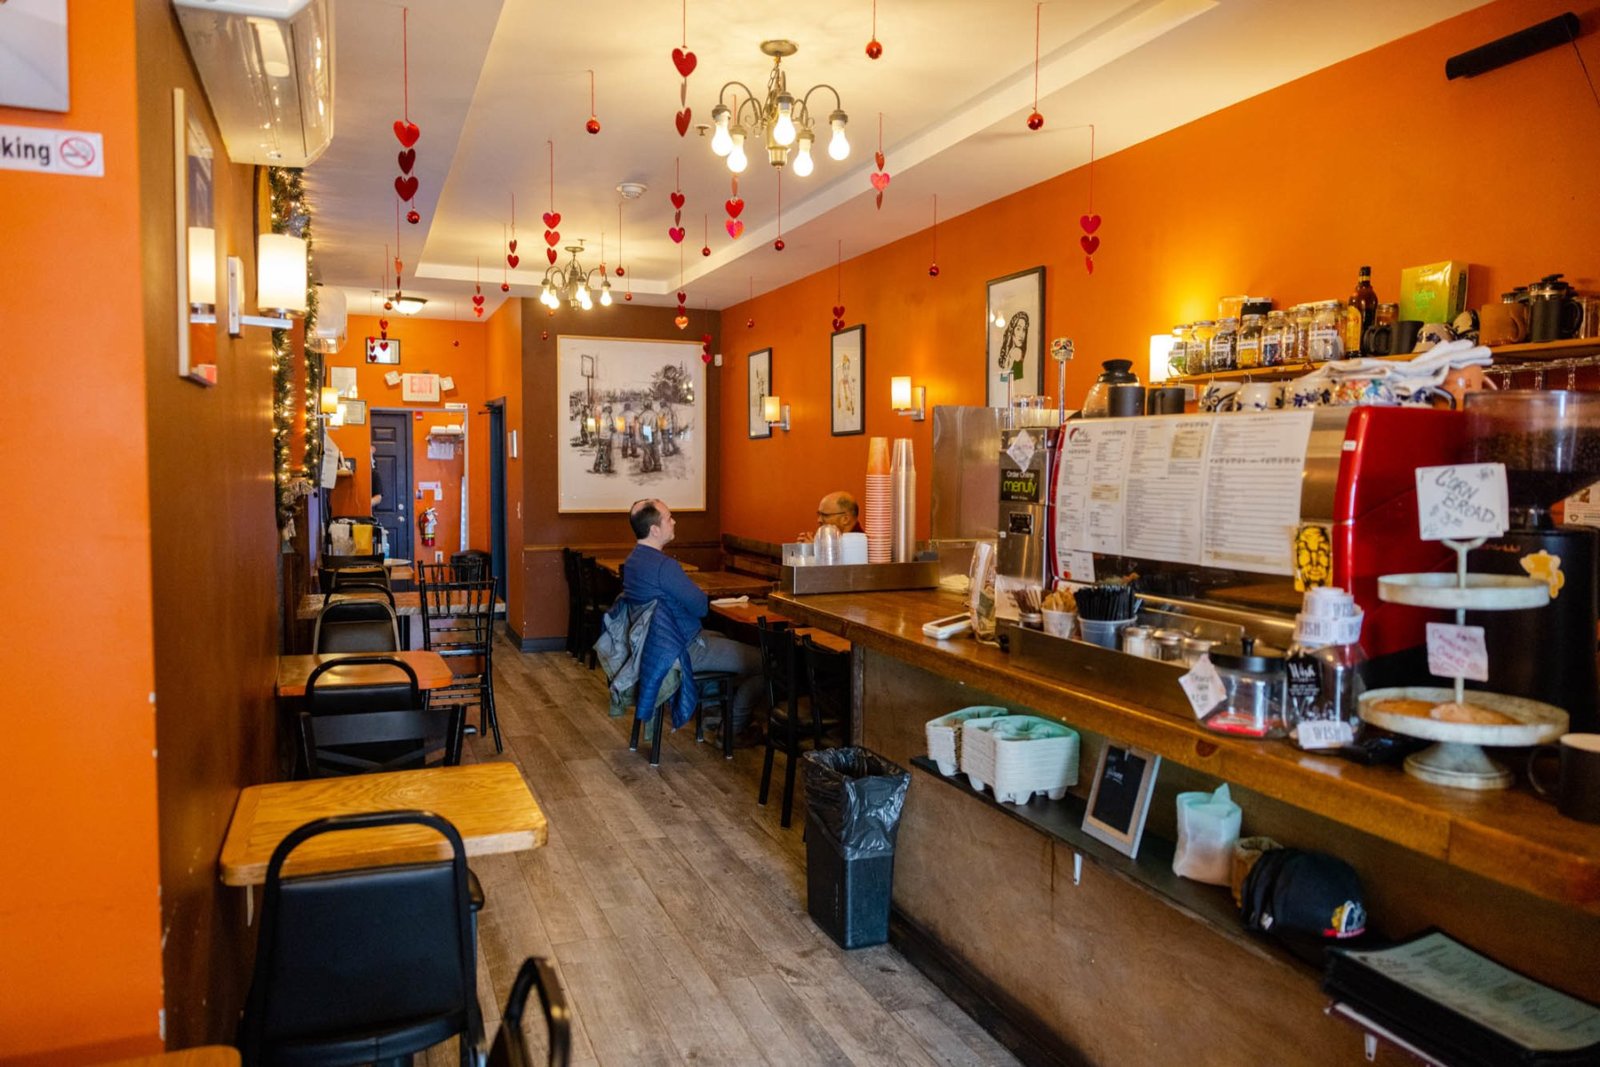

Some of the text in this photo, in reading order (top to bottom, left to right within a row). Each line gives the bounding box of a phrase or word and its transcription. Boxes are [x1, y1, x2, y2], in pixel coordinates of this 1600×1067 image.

[0, 136, 50, 167] king
[410, 375, 433, 394] EXIT
[1006, 470, 1019, 478] Order
[1435, 466, 1480, 499] CORN
